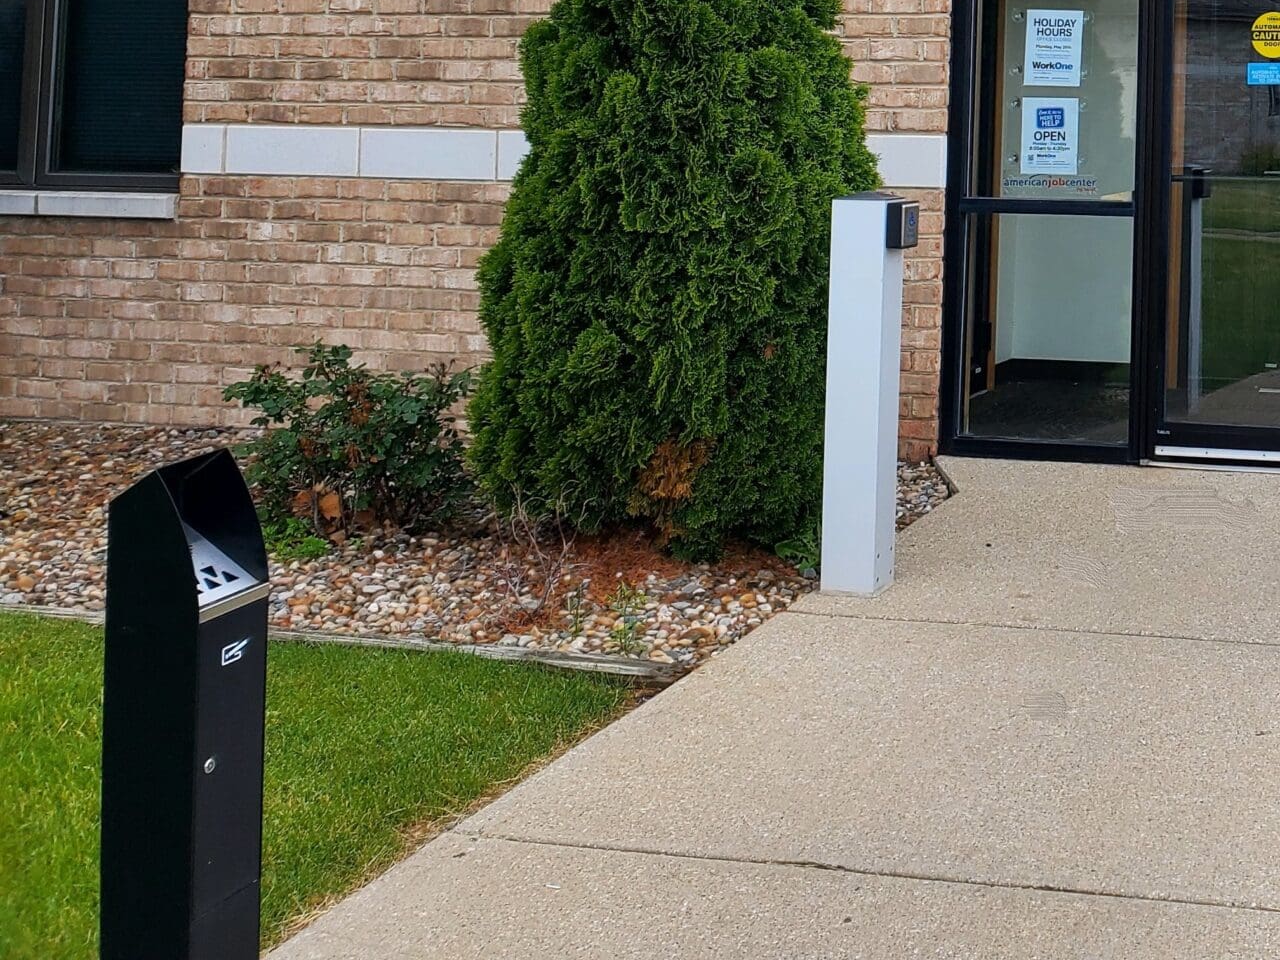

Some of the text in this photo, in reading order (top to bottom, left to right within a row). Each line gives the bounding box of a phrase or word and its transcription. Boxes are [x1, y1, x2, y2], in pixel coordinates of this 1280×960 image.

[1033, 18, 1077, 28] HOLIDAY
[1036, 27, 1073, 37] HOURS
[1032, 61, 1074, 70] WorkOne
[1041, 119, 1060, 127] HELP
[1033, 131, 1066, 142] OPEN
[1003, 177, 1097, 189] americanjobcenter
